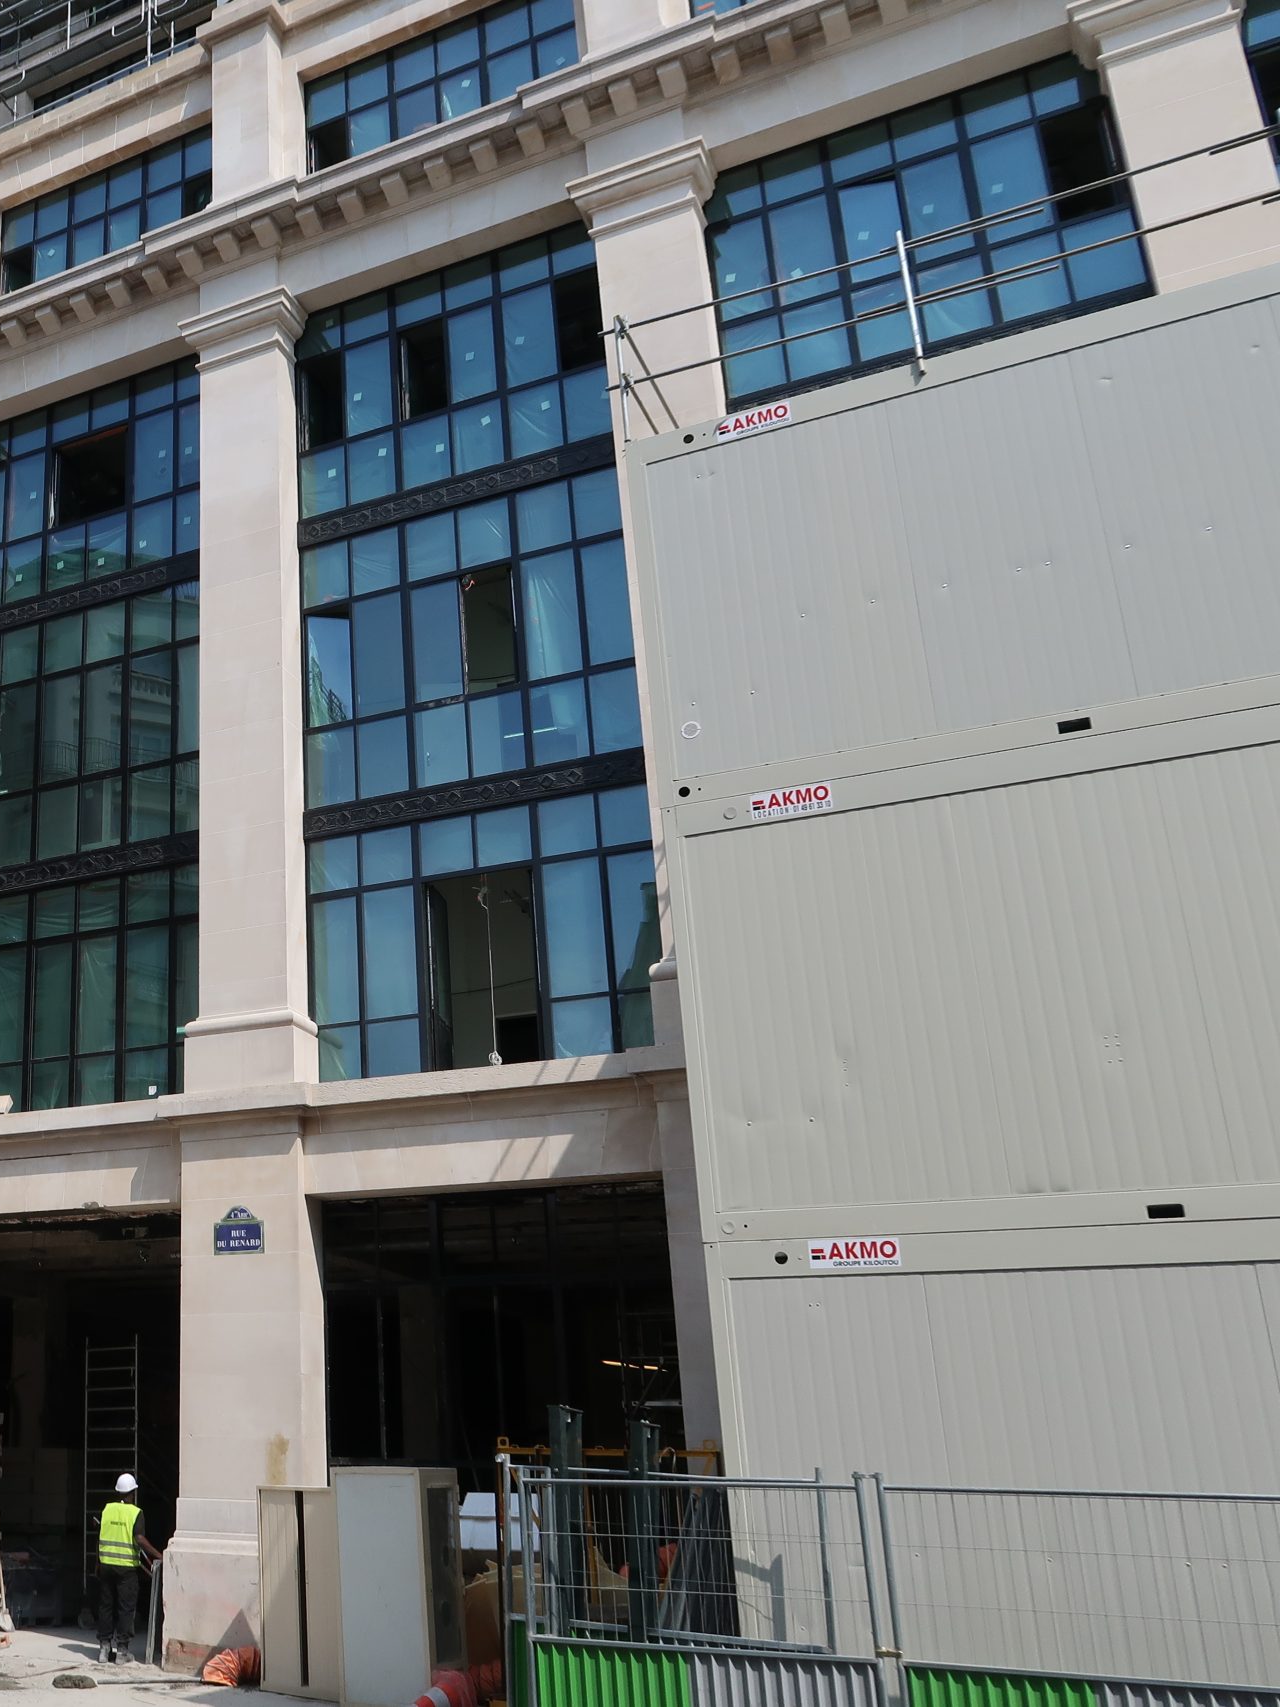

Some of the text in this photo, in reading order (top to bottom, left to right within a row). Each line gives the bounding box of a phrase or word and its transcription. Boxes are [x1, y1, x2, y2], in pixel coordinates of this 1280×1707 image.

[733, 404, 788, 431] AKMO
[736, 425, 760, 436] GROUPE
[768, 785, 829, 809] AKMO
[753, 807, 790, 819] LOCATION
[231, 1230, 247, 1238] RUE
[217, 1239, 261, 1248] DU RENARD
[829, 1240, 897, 1260] AKMO
